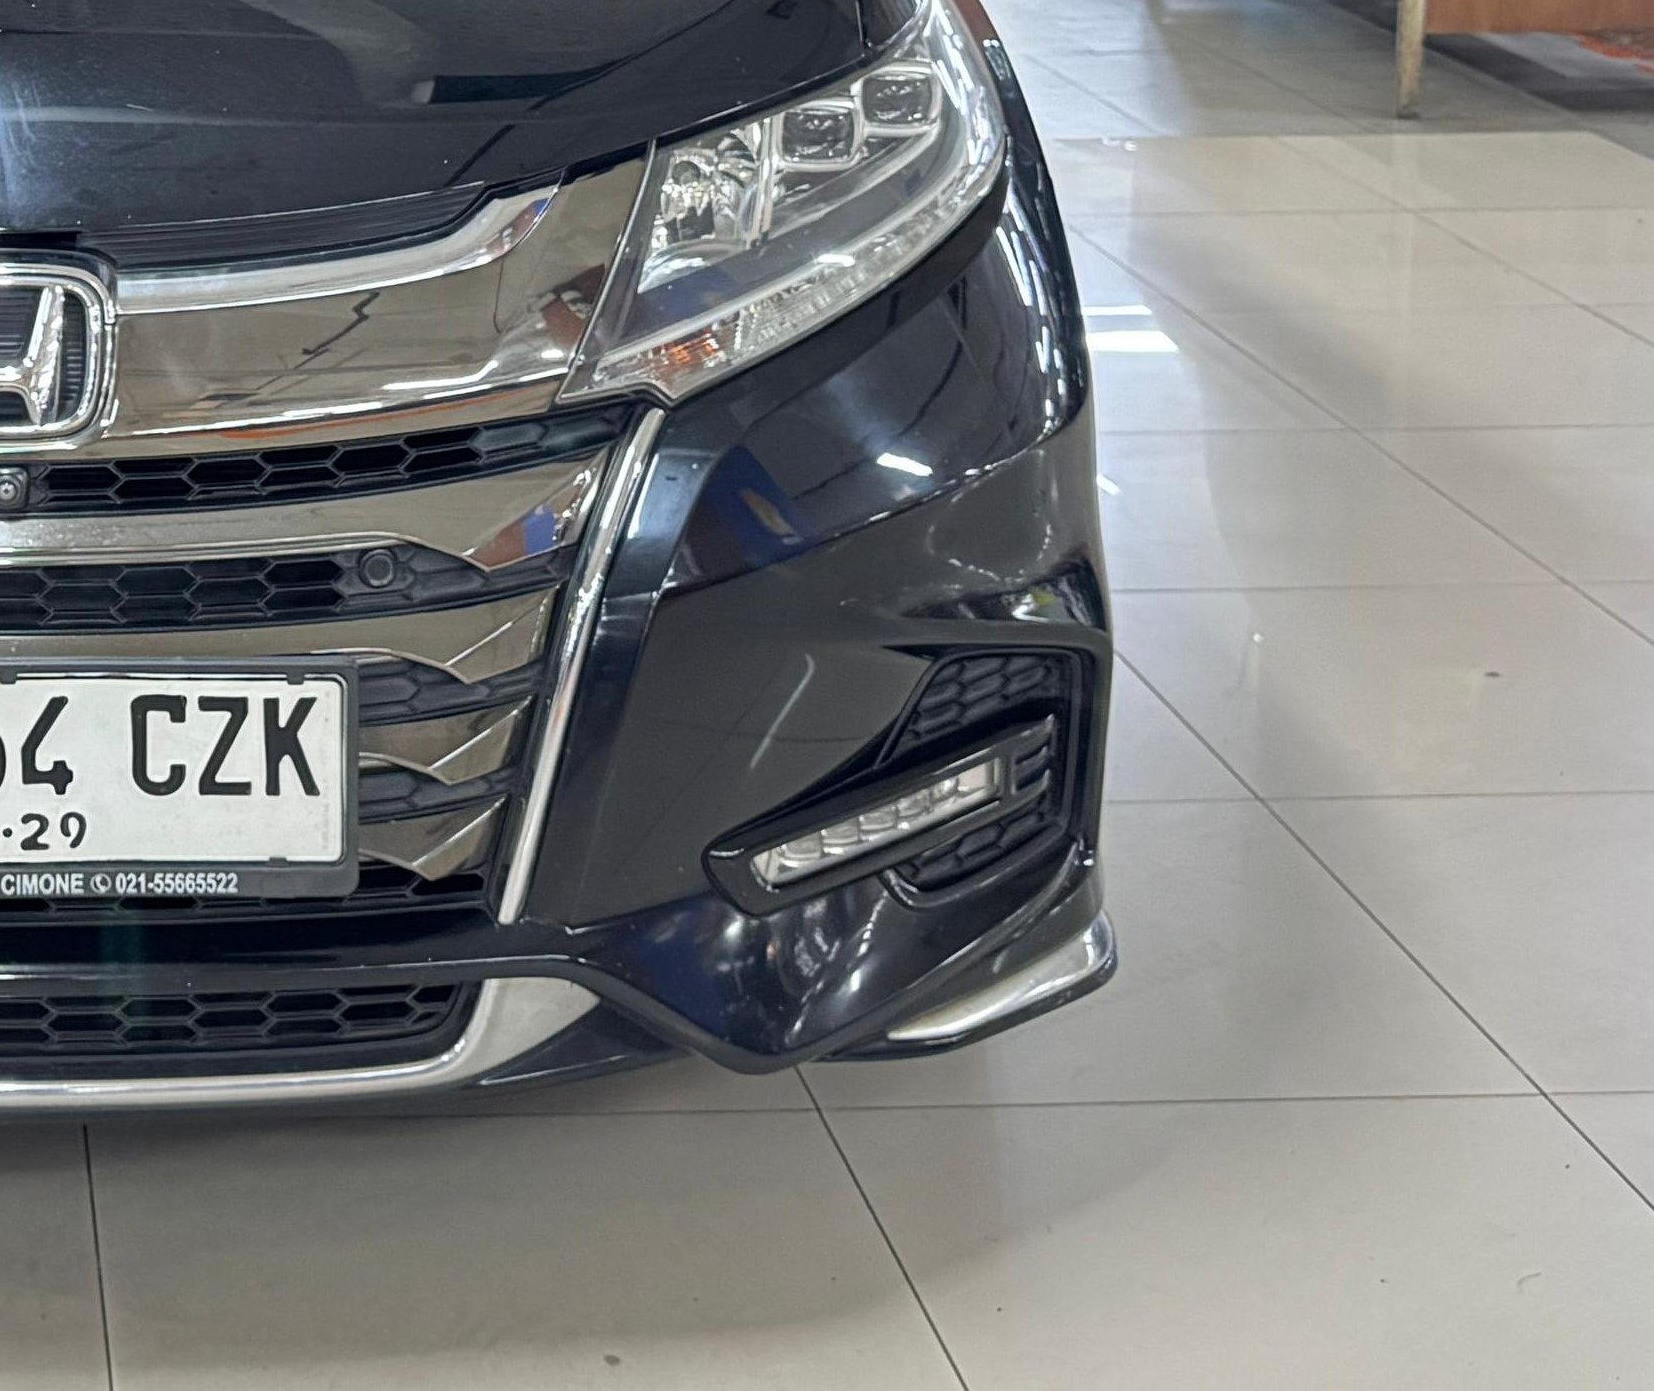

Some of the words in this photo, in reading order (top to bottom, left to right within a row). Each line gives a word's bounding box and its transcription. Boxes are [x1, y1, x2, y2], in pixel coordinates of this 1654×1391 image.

[131, 695, 320, 796] CZK
[0, 873, 85, 896] CIMONE
[115, 872, 238, 895] 021-55665522
